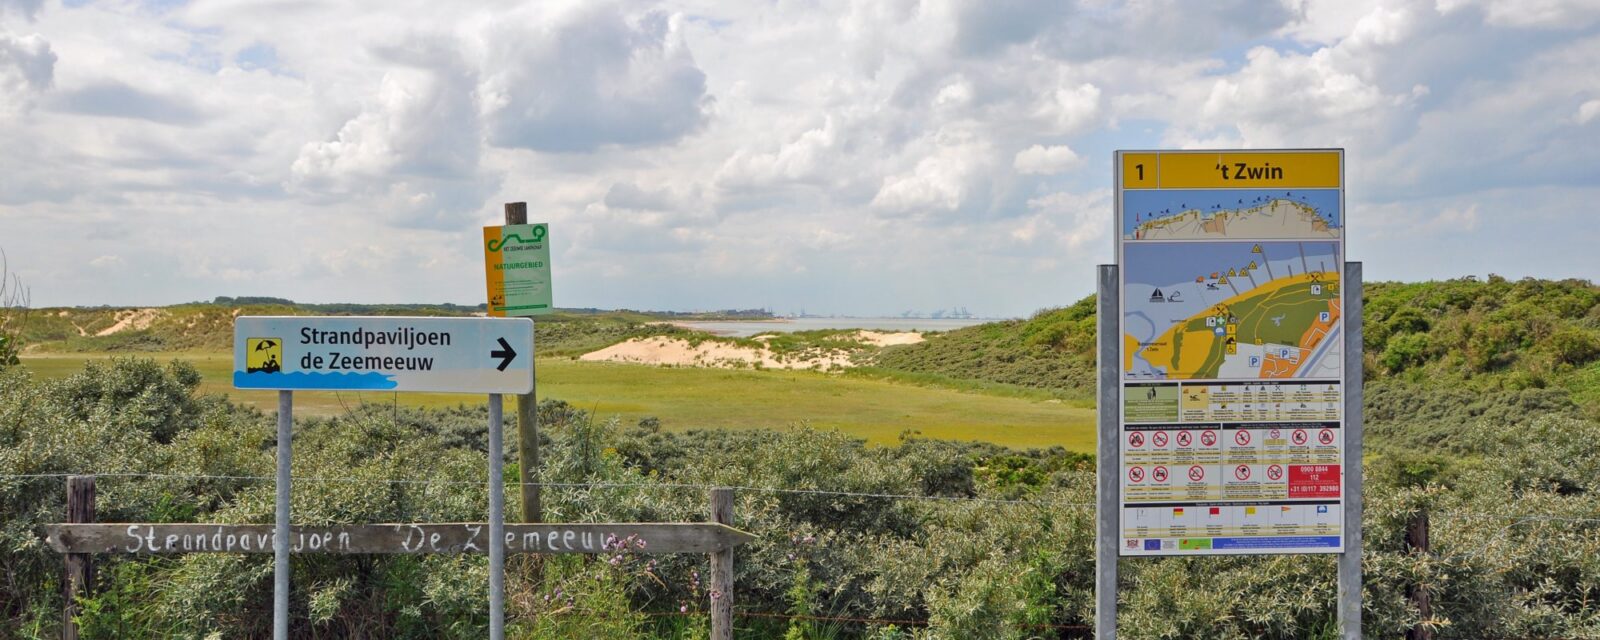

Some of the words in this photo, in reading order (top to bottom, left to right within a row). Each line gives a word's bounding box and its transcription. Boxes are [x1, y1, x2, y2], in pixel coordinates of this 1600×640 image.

[1135, 163, 1144, 181] 1
[1234, 162, 1283, 180] Zwin
[494, 261, 543, 271] NATUURGEBIED
[300, 327, 451, 350] Strandpaviljoen
[301, 352, 323, 369] de
[329, 352, 434, 370] Zeemeeuw
